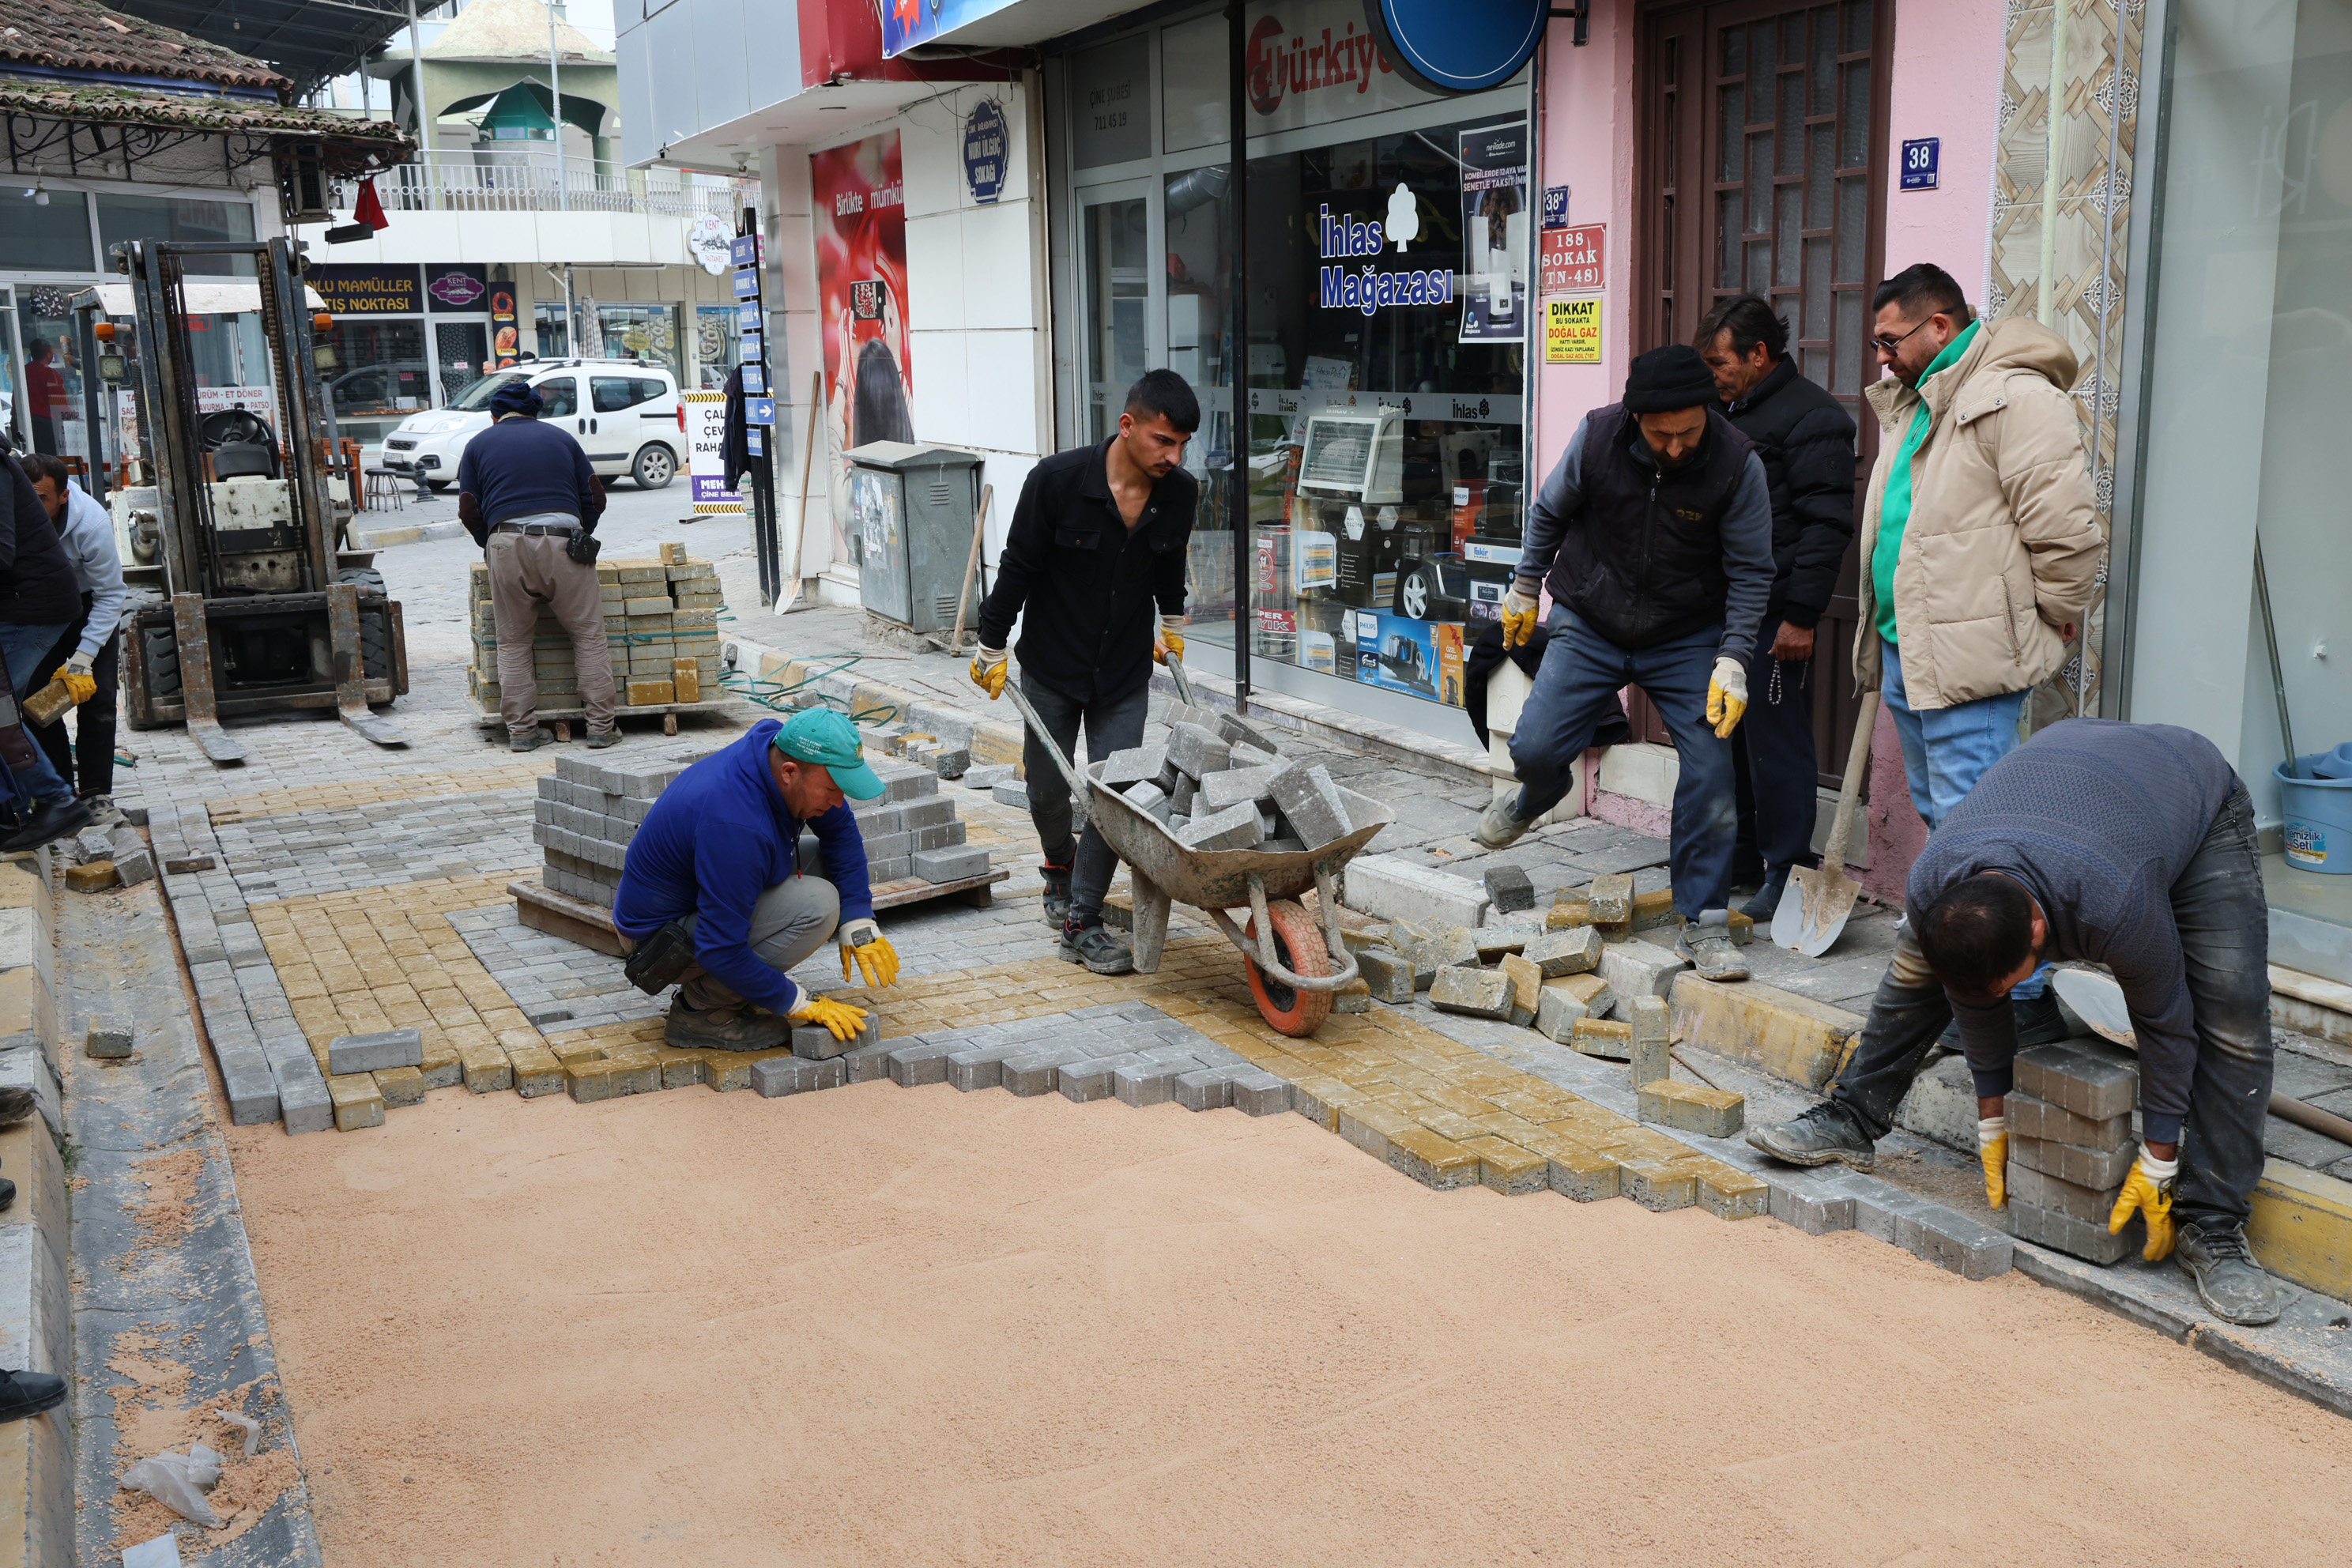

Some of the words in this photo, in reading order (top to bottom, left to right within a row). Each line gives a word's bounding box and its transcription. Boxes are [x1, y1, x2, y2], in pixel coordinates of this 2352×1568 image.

[1090, 87, 1105, 109] ÇİNE
[1107, 80, 1131, 106] ŞUBESİ
[1095, 115, 1106, 130] 711
[1108, 113, 1117, 128] 45
[1119, 111, 1127, 126] 19
[968, 138, 982, 160] NURİ
[982, 133, 1001, 157] ÜLGÜÇ
[1909, 145, 1929, 169] 38
[974, 160, 996, 185] SOKAĞI
[1464, 168, 1499, 181] KOMBİLERDE
[1506, 166, 1517, 175] AYA
[1464, 180, 1491, 192] SENETLE
[1492, 175, 1514, 188] TAKSİT
[836, 190, 863, 217] Birlikte
[705, 220, 720, 230] KENT
[1321, 203, 1382, 258] İhlas
[1557, 232, 1584, 247] 188
[1543, 250, 1596, 267] SOKAK
[338, 277, 413, 292] MAMÜLLER
[1321, 265, 1453, 316] Mağazası
[349, 298, 409, 311] NOKTASI
[1551, 302, 1594, 315] DİKKAT
[1549, 326, 1577, 338] DOĞAL
[1579, 326, 1597, 337] GAZ
[237, 389, 263, 398] DÖNER
[251, 401, 270, 410] PATSO
[1453, 398, 1478, 419] İhlas
[701, 490, 719, 499] ÇİNE
[1359, 621, 1377, 631] PHILIPS
[2287, 827, 2320, 841] Temizlik
[2293, 839, 2312, 850] Seti
